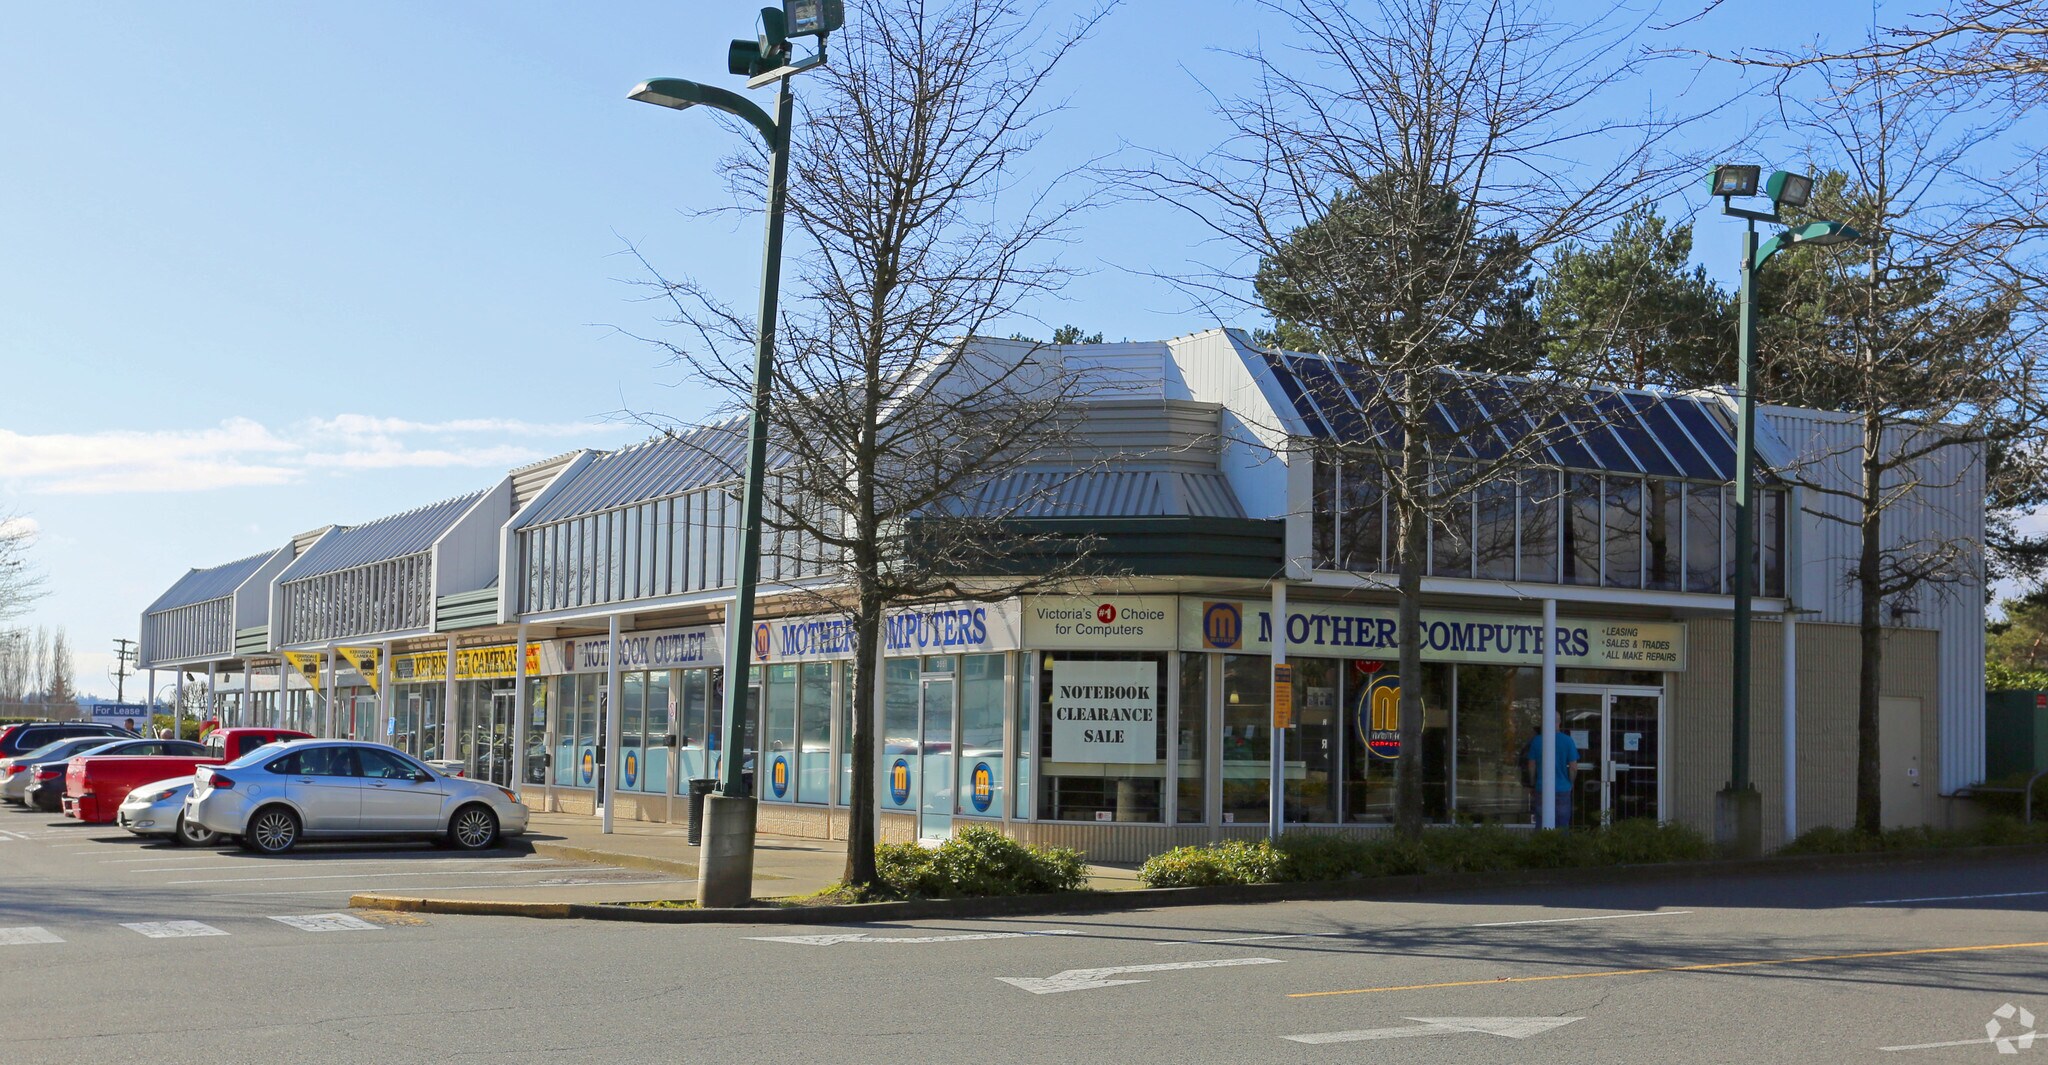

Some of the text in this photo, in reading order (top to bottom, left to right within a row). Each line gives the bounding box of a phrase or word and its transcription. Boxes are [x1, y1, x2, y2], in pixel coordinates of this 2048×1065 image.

[1037, 607, 1165, 620] Victoria's #1 Choice
[884, 607, 987, 650] MPUTERS
[1055, 623, 1144, 638] for Computers
[1605, 627, 1638, 637] LEASING
[654, 632, 706, 664] OUTLET
[1605, 639, 1670, 650] SALES & TRADES
[1605, 651, 1677, 662] ALL MAKE REPAIRS
[1060, 685, 1150, 700] NOTEBOOK
[95, 706, 141, 715] For Lease
[1056, 707, 1153, 722] CLEARANCE
[1083, 729, 1125, 744] SALE
